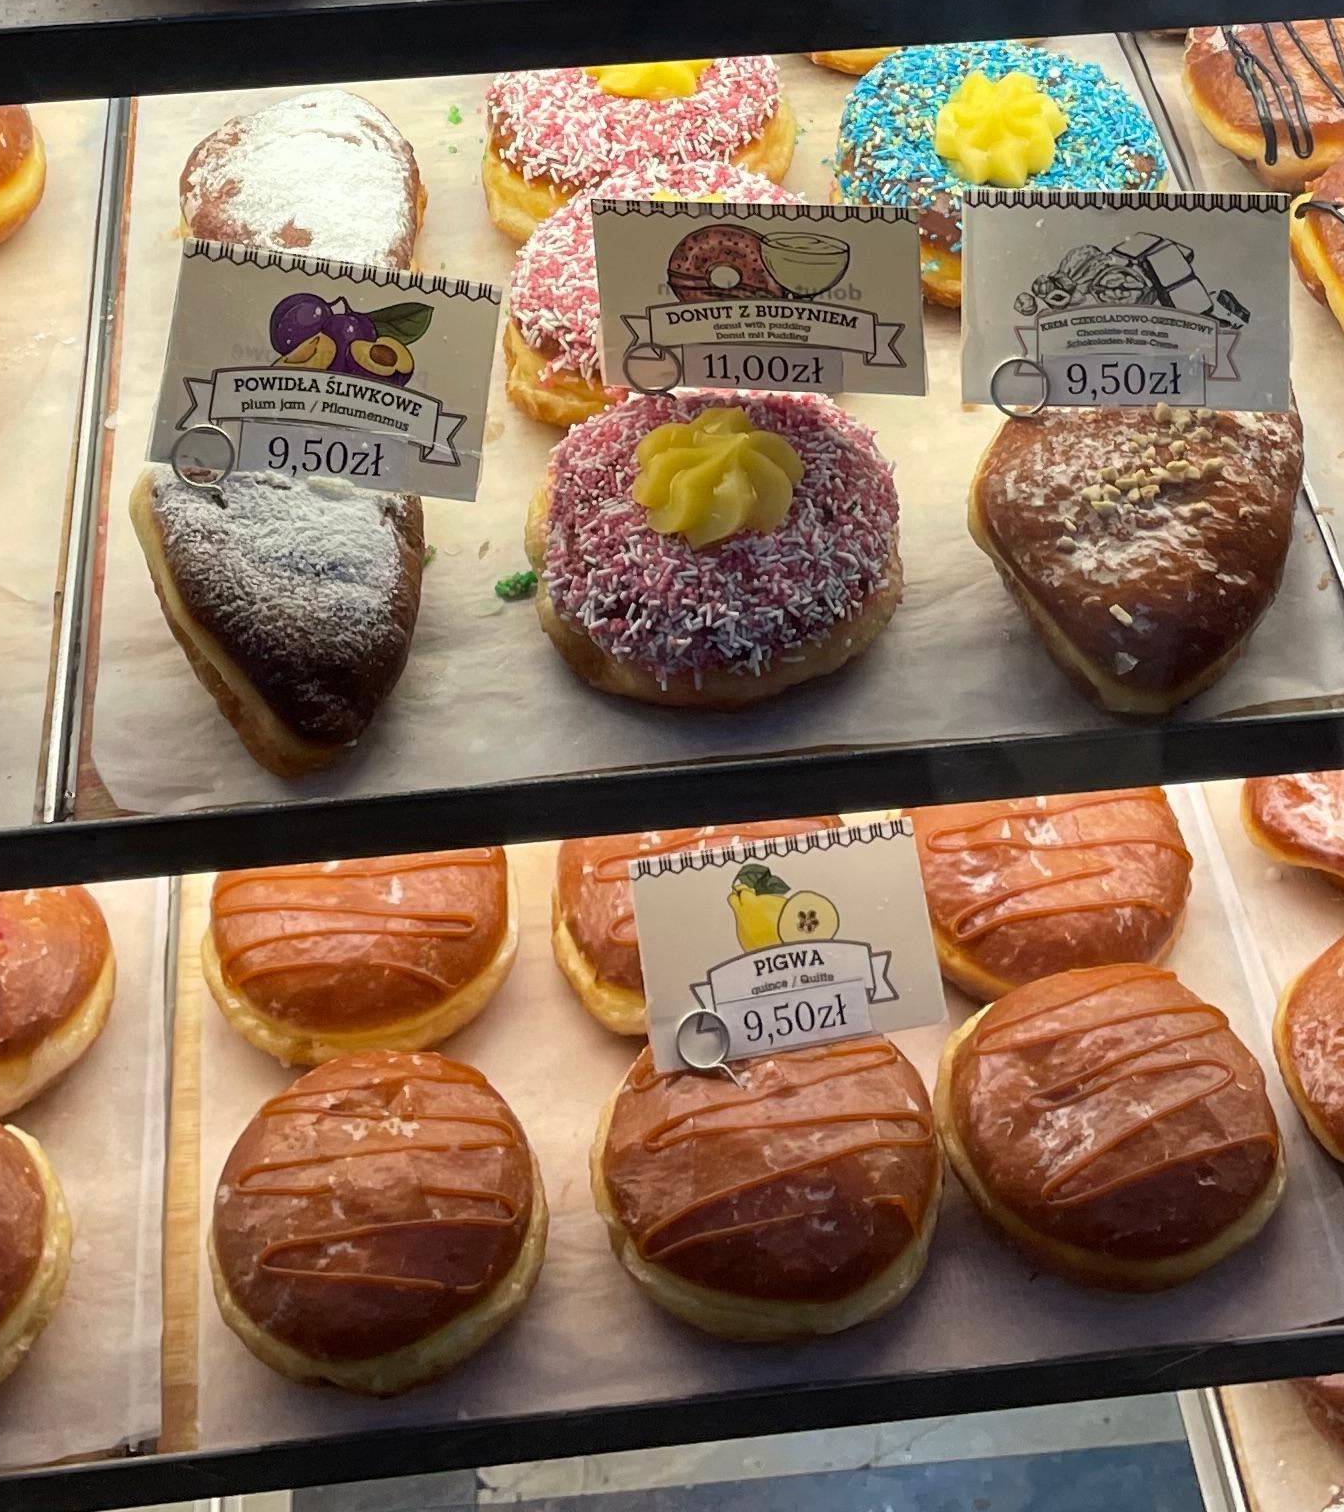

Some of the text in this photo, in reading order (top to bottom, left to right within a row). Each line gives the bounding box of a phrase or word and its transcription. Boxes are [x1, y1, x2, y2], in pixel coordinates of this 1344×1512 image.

[667, 305, 859, 329] DONUT Z BUDYNIEM
[703, 353, 824, 384] 11,00zł
[1067, 361, 1181, 401] 9,50zł
[234, 376, 422, 417] POWIDŁA ŚLIWKOWE
[241, 399, 276, 412] plum
[279, 399, 305, 411] jam
[321, 401, 409, 432] Pflaumenmus
[268, 436, 384, 477] 9,50zł
[754, 950, 824, 976] PIGWA
[743, 994, 848, 1045] 9,50zł
